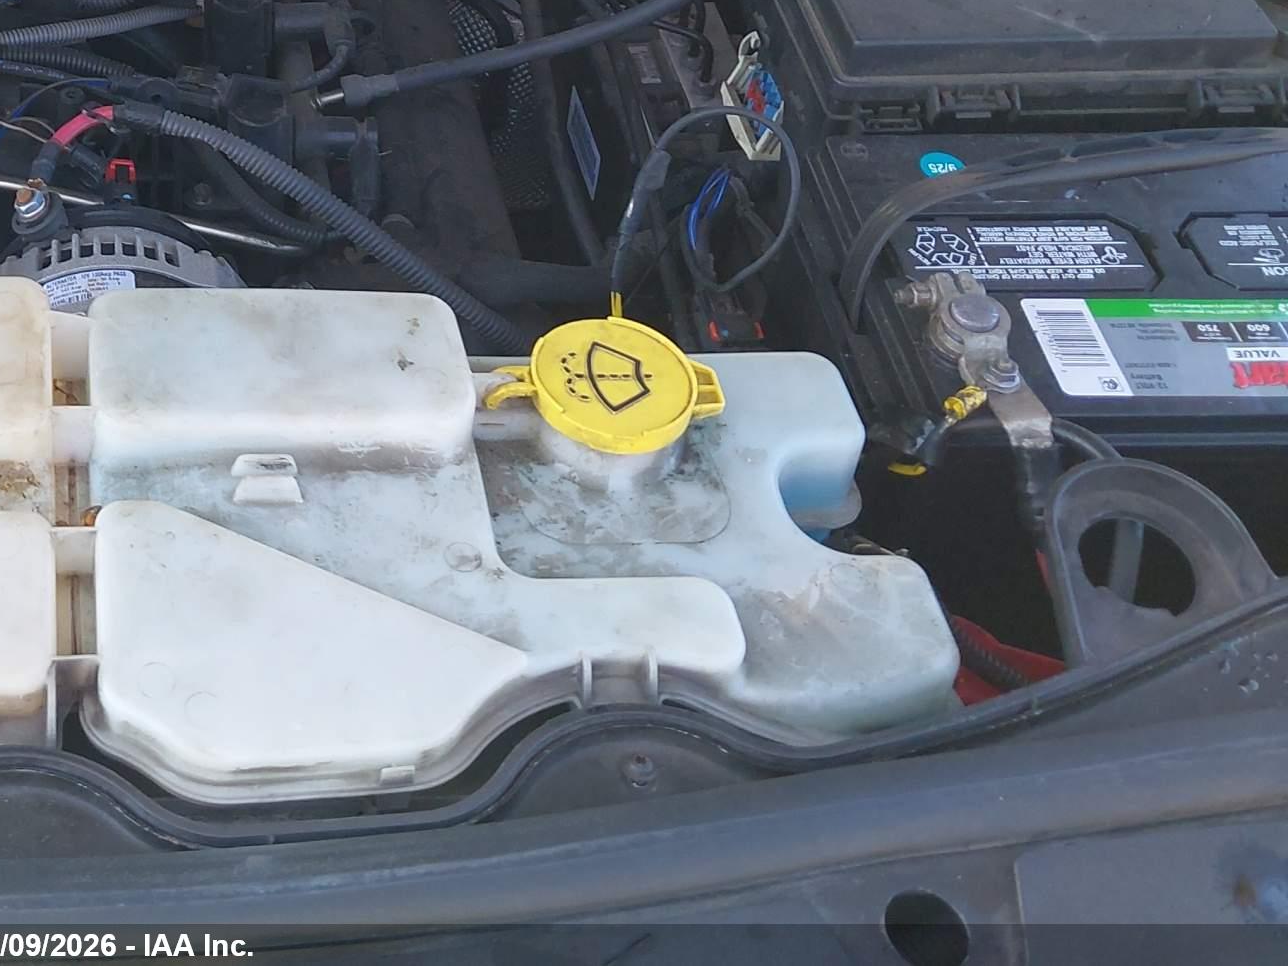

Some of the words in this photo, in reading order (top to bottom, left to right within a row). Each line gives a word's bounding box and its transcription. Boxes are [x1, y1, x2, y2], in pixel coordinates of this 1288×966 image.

[1197, 324, 1222, 332] 750
[1246, 324, 1270, 332] 600
[1232, 350, 1280, 359] VALUE
